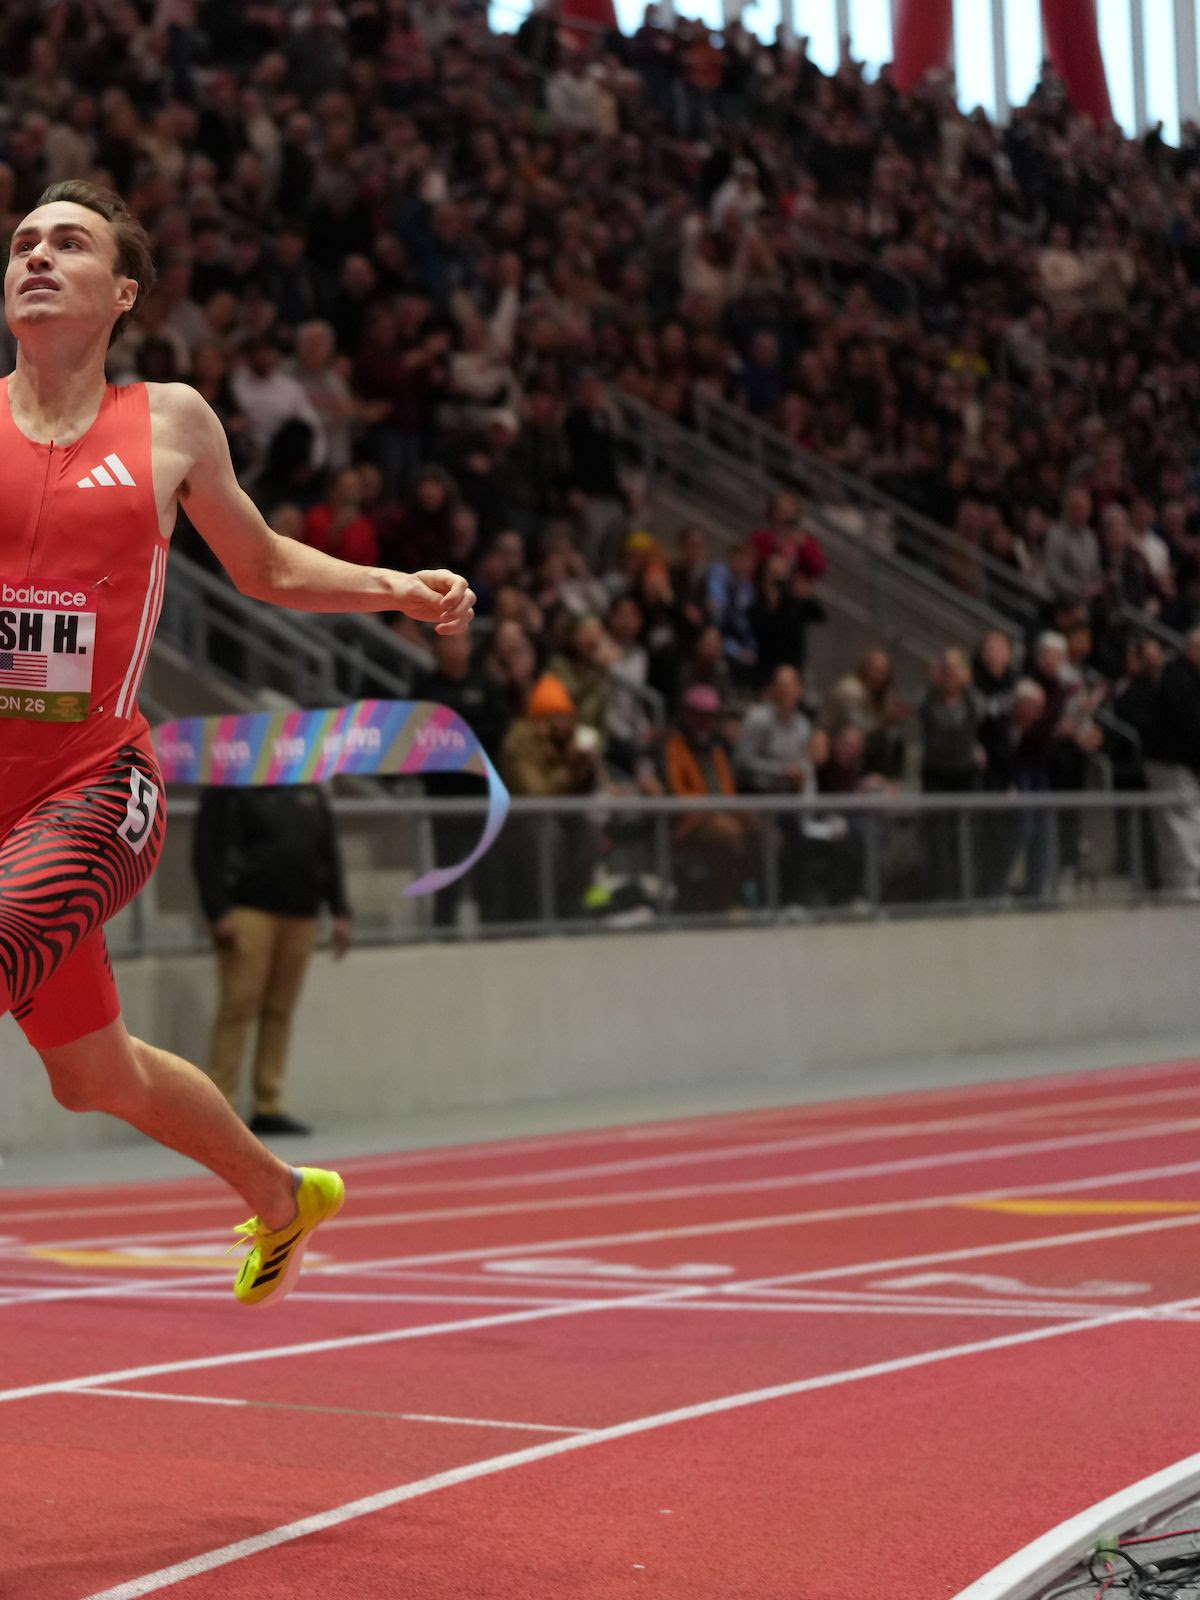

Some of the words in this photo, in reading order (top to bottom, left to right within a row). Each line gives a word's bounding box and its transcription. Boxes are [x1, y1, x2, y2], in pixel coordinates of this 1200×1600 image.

[2, 584, 87, 607] balance
[52, 614, 87, 655] H.
[24, 697, 46, 713] 26
[125, 778, 153, 844] 5
